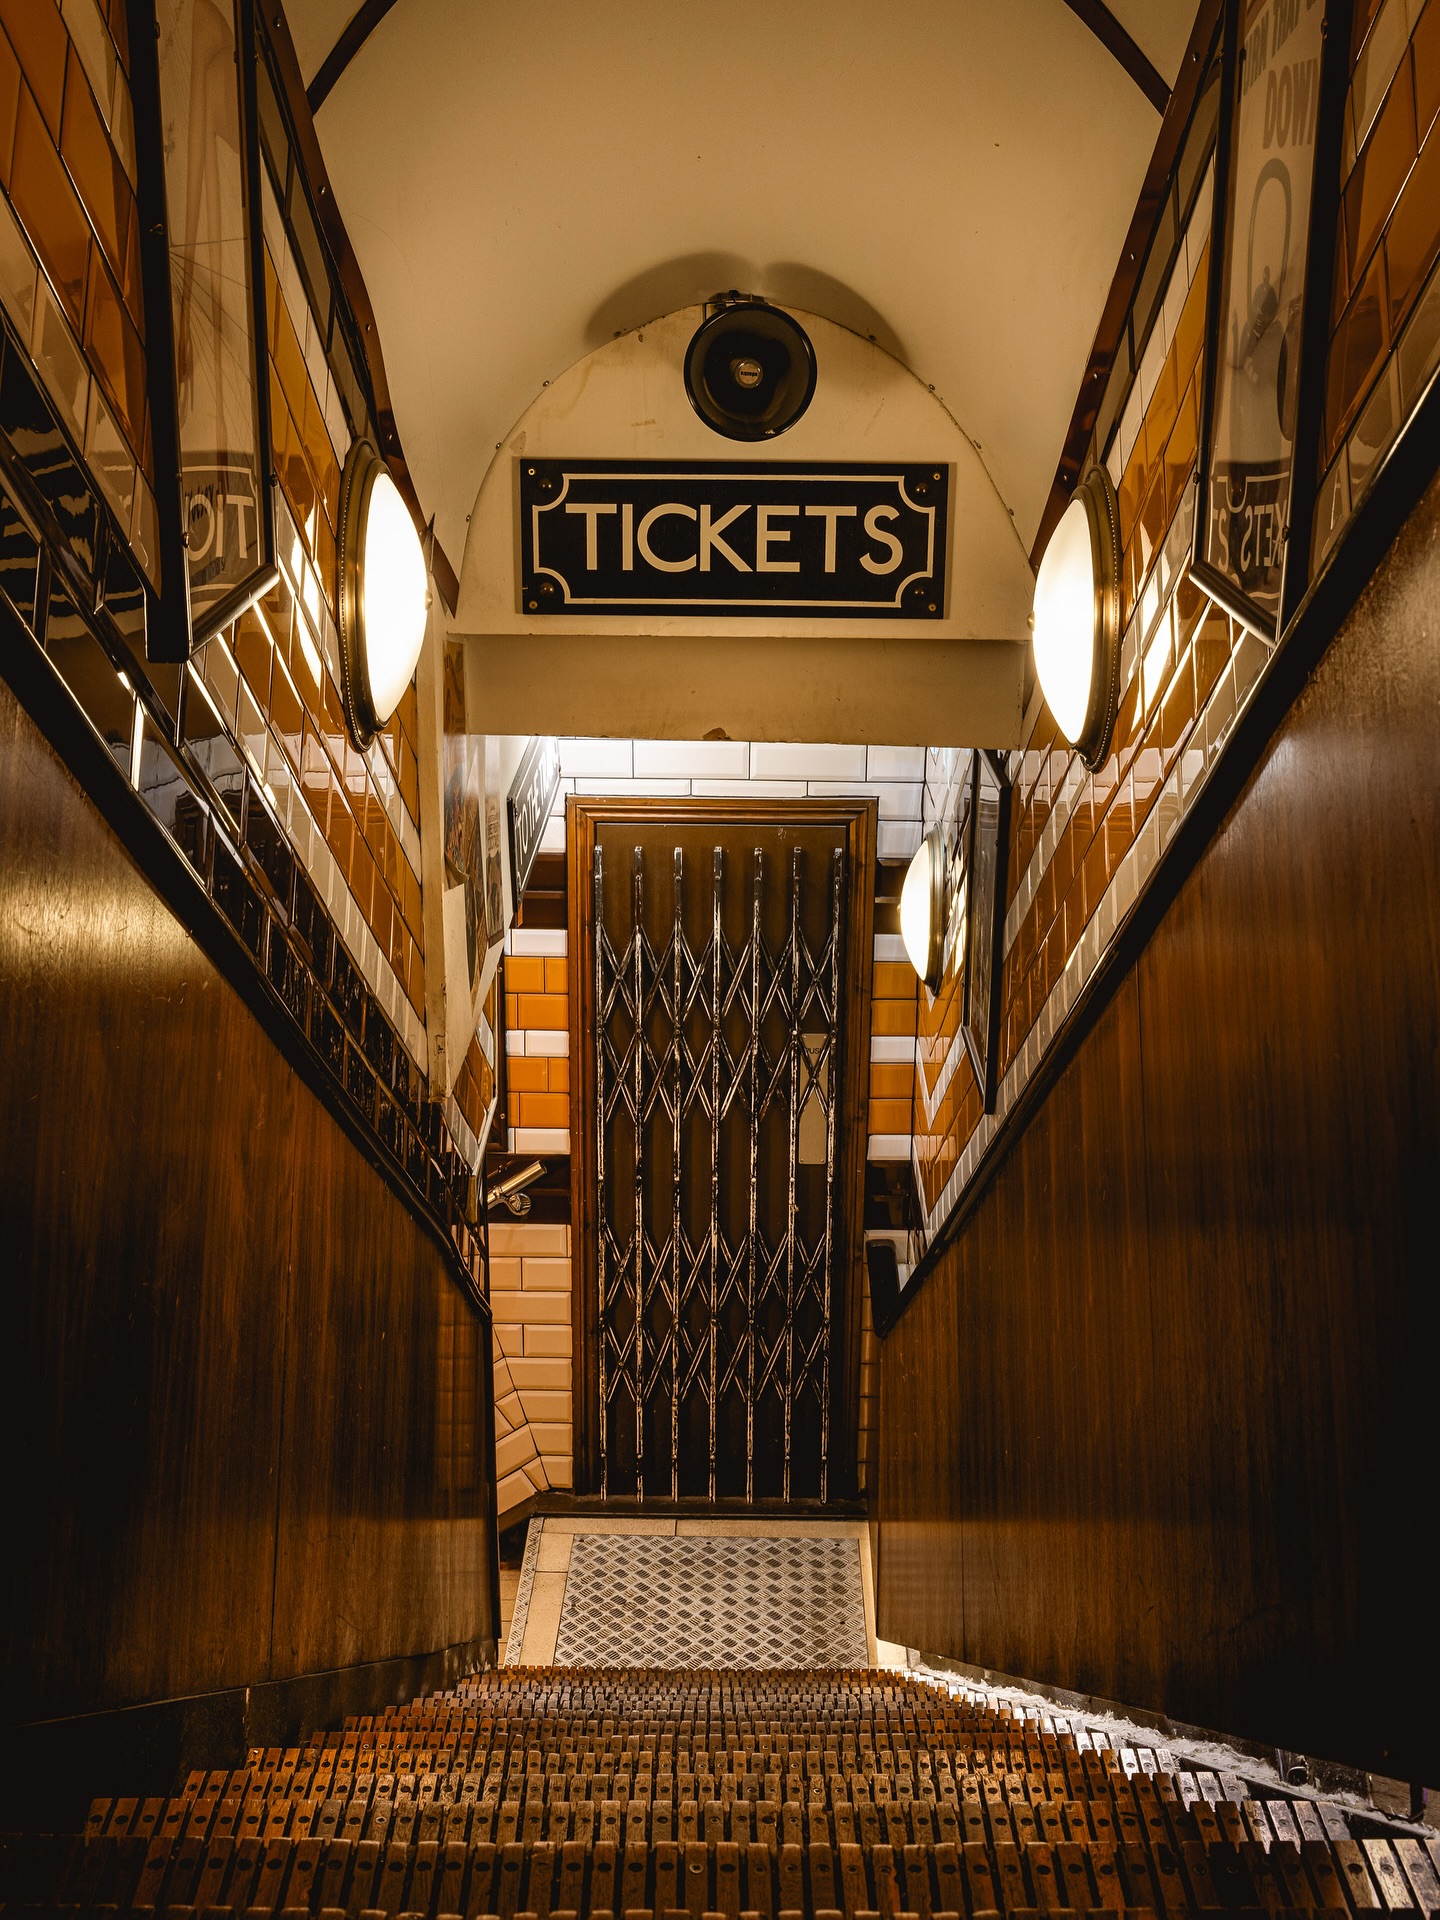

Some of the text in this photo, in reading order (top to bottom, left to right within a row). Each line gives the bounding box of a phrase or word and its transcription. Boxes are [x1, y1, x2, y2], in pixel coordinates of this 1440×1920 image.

[565, 502, 904, 576] TICKETS
[518, 767, 541, 866] TO THE
[805, 1047, 824, 1055] PUS
